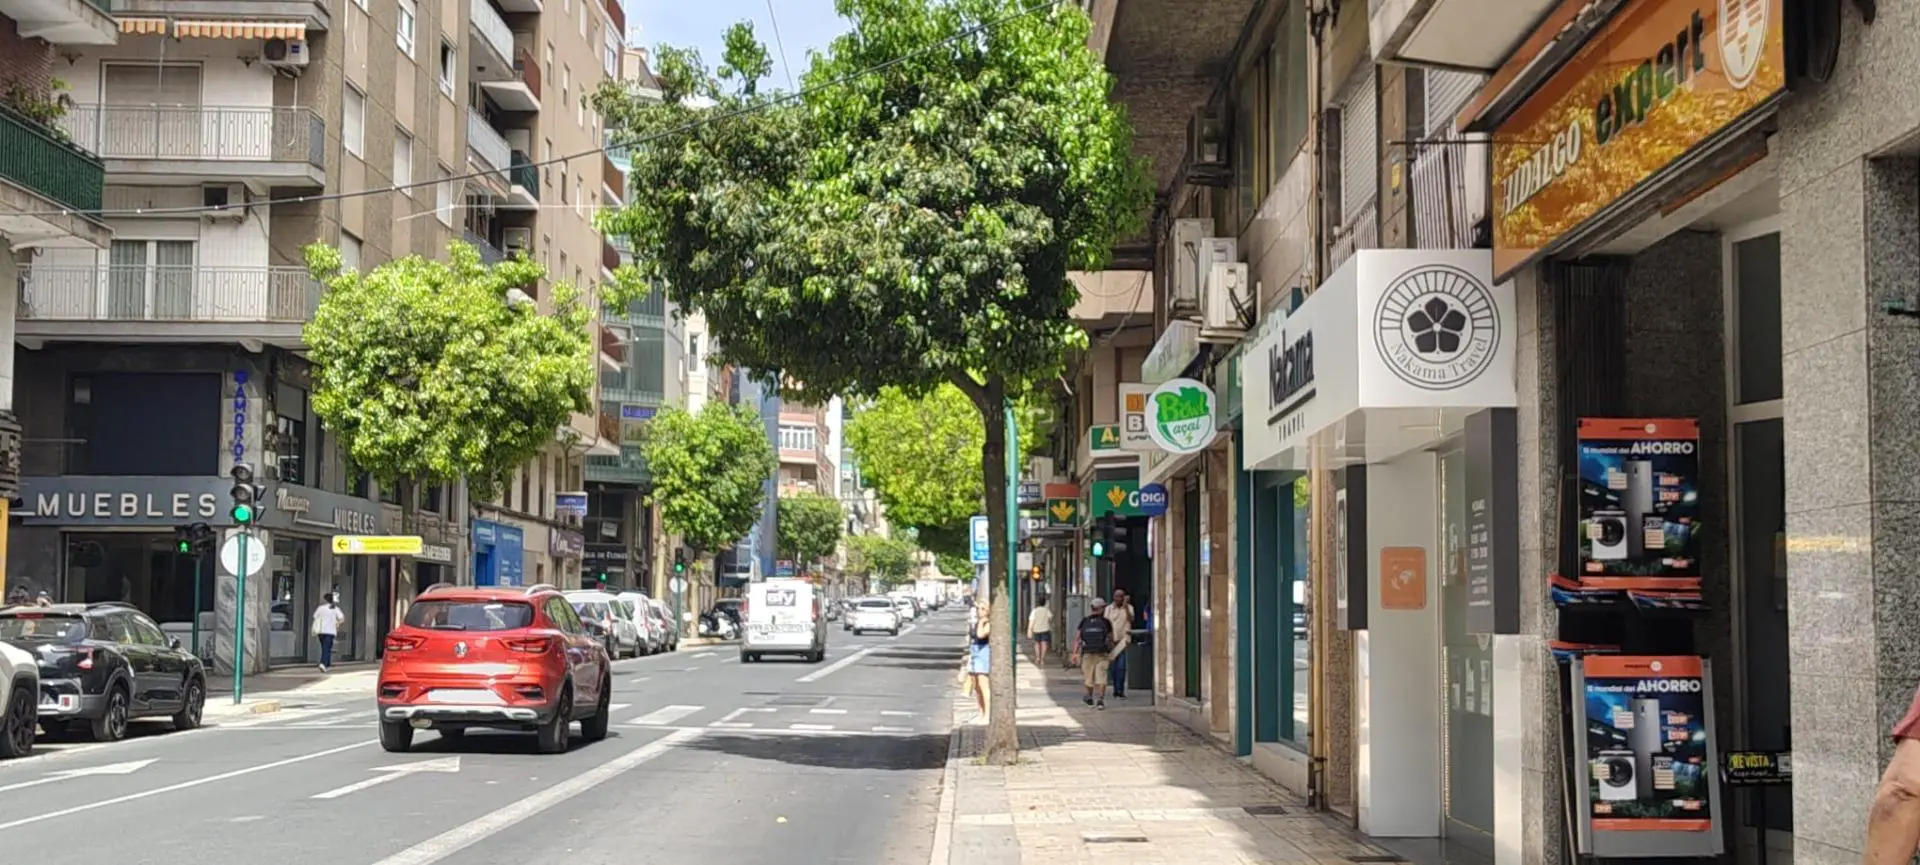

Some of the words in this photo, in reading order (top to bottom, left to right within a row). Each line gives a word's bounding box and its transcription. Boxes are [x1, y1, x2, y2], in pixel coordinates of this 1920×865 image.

[1501, 119, 1582, 216] HIDALGO
[1595, 8, 1706, 145] expert
[1269, 328, 1315, 412] Nakama
[1391, 342, 1446, 380] Nakama
[1447, 336, 1488, 377] Travel
[1278, 410, 1305, 442] TRAVEL
[1630, 441, 1694, 455] AHORRO
[37, 493, 216, 517] MUEBLES
[334, 508, 375, 534] MUEBLES
[1636, 680, 1700, 693] AHORRO
[1731, 755, 1769, 769] REVISTA
